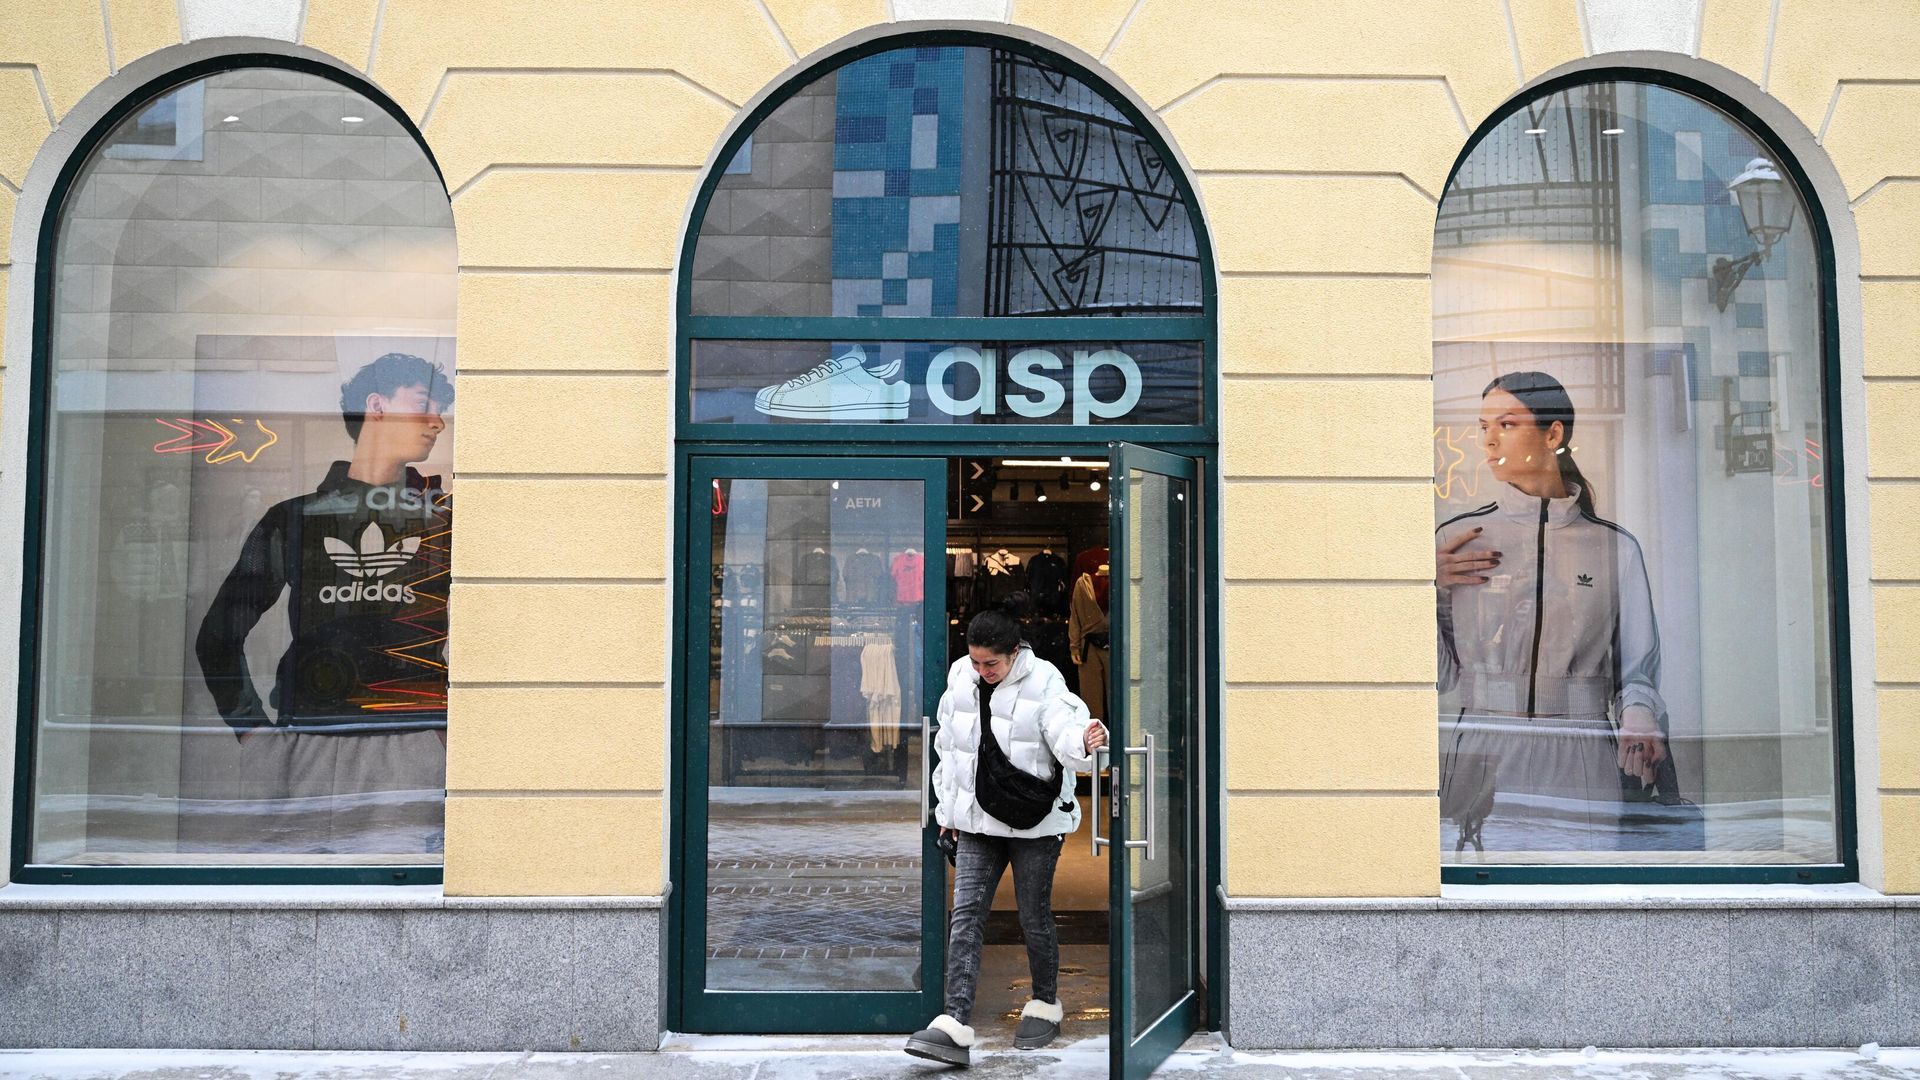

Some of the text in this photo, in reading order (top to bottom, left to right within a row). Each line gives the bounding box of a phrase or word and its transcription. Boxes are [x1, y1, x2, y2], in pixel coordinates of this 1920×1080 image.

[926, 346, 1143, 425] asp
[845, 497, 881, 510] ДЕТИ
[318, 580, 417, 604] adidas
